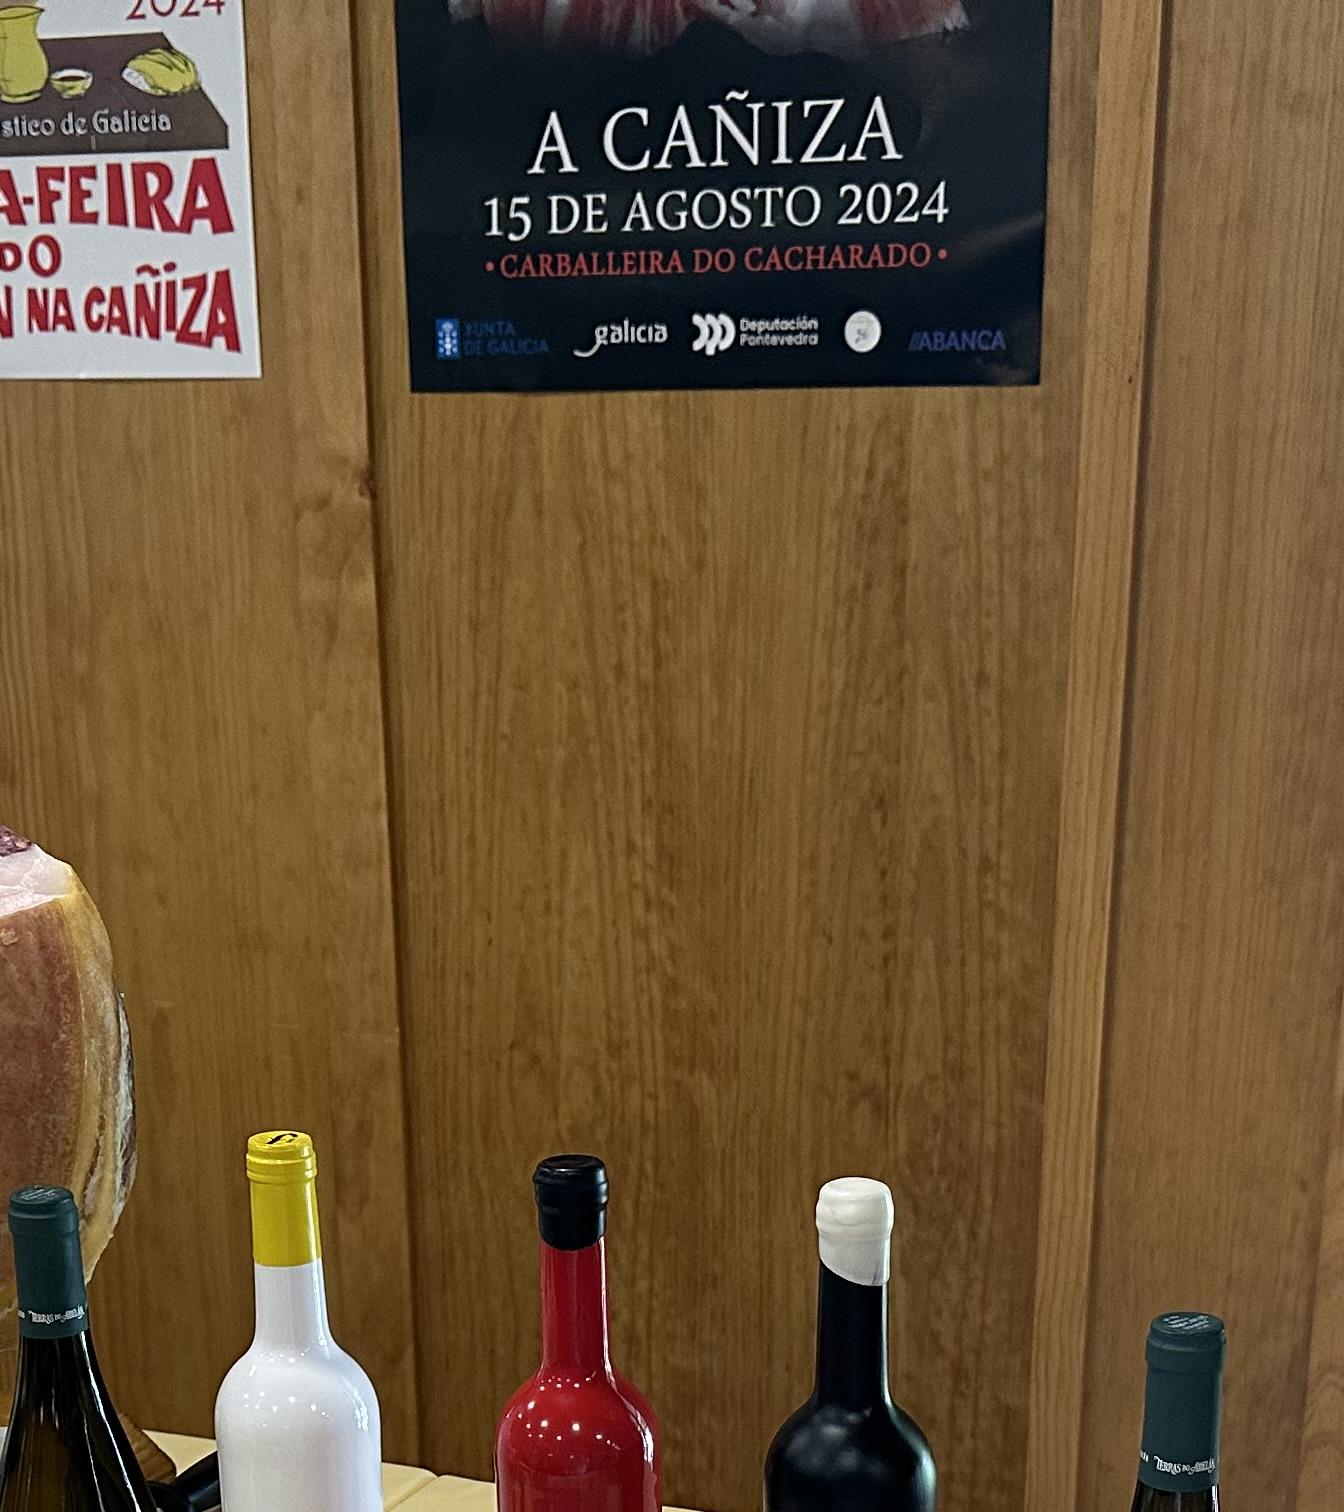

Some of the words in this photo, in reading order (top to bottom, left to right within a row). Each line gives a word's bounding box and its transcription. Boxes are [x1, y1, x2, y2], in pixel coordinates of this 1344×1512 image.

[59, 112, 88, 136] de
[91, 108, 172, 135] Galicia
[526, 110, 579, 175] A
[602, 89, 903, 172] CAÑIZA
[483, 196, 533, 242] 15
[548, 194, 609, 235] DE
[621, 185, 822, 232] AGOSTO
[836, 180, 949, 226] 2024
[500, 249, 685, 279] CARBALLEIRA
[692, 248, 736, 273] DO
[742, 241, 931, 272] CACHARADO
[26, 285, 75, 334] NA
[84, 262, 242, 354] CAÑIZA
[739, 314, 818, 331] Deputación
[572, 316, 669, 359] galicia
[739, 331, 818, 347] Pontevedra
